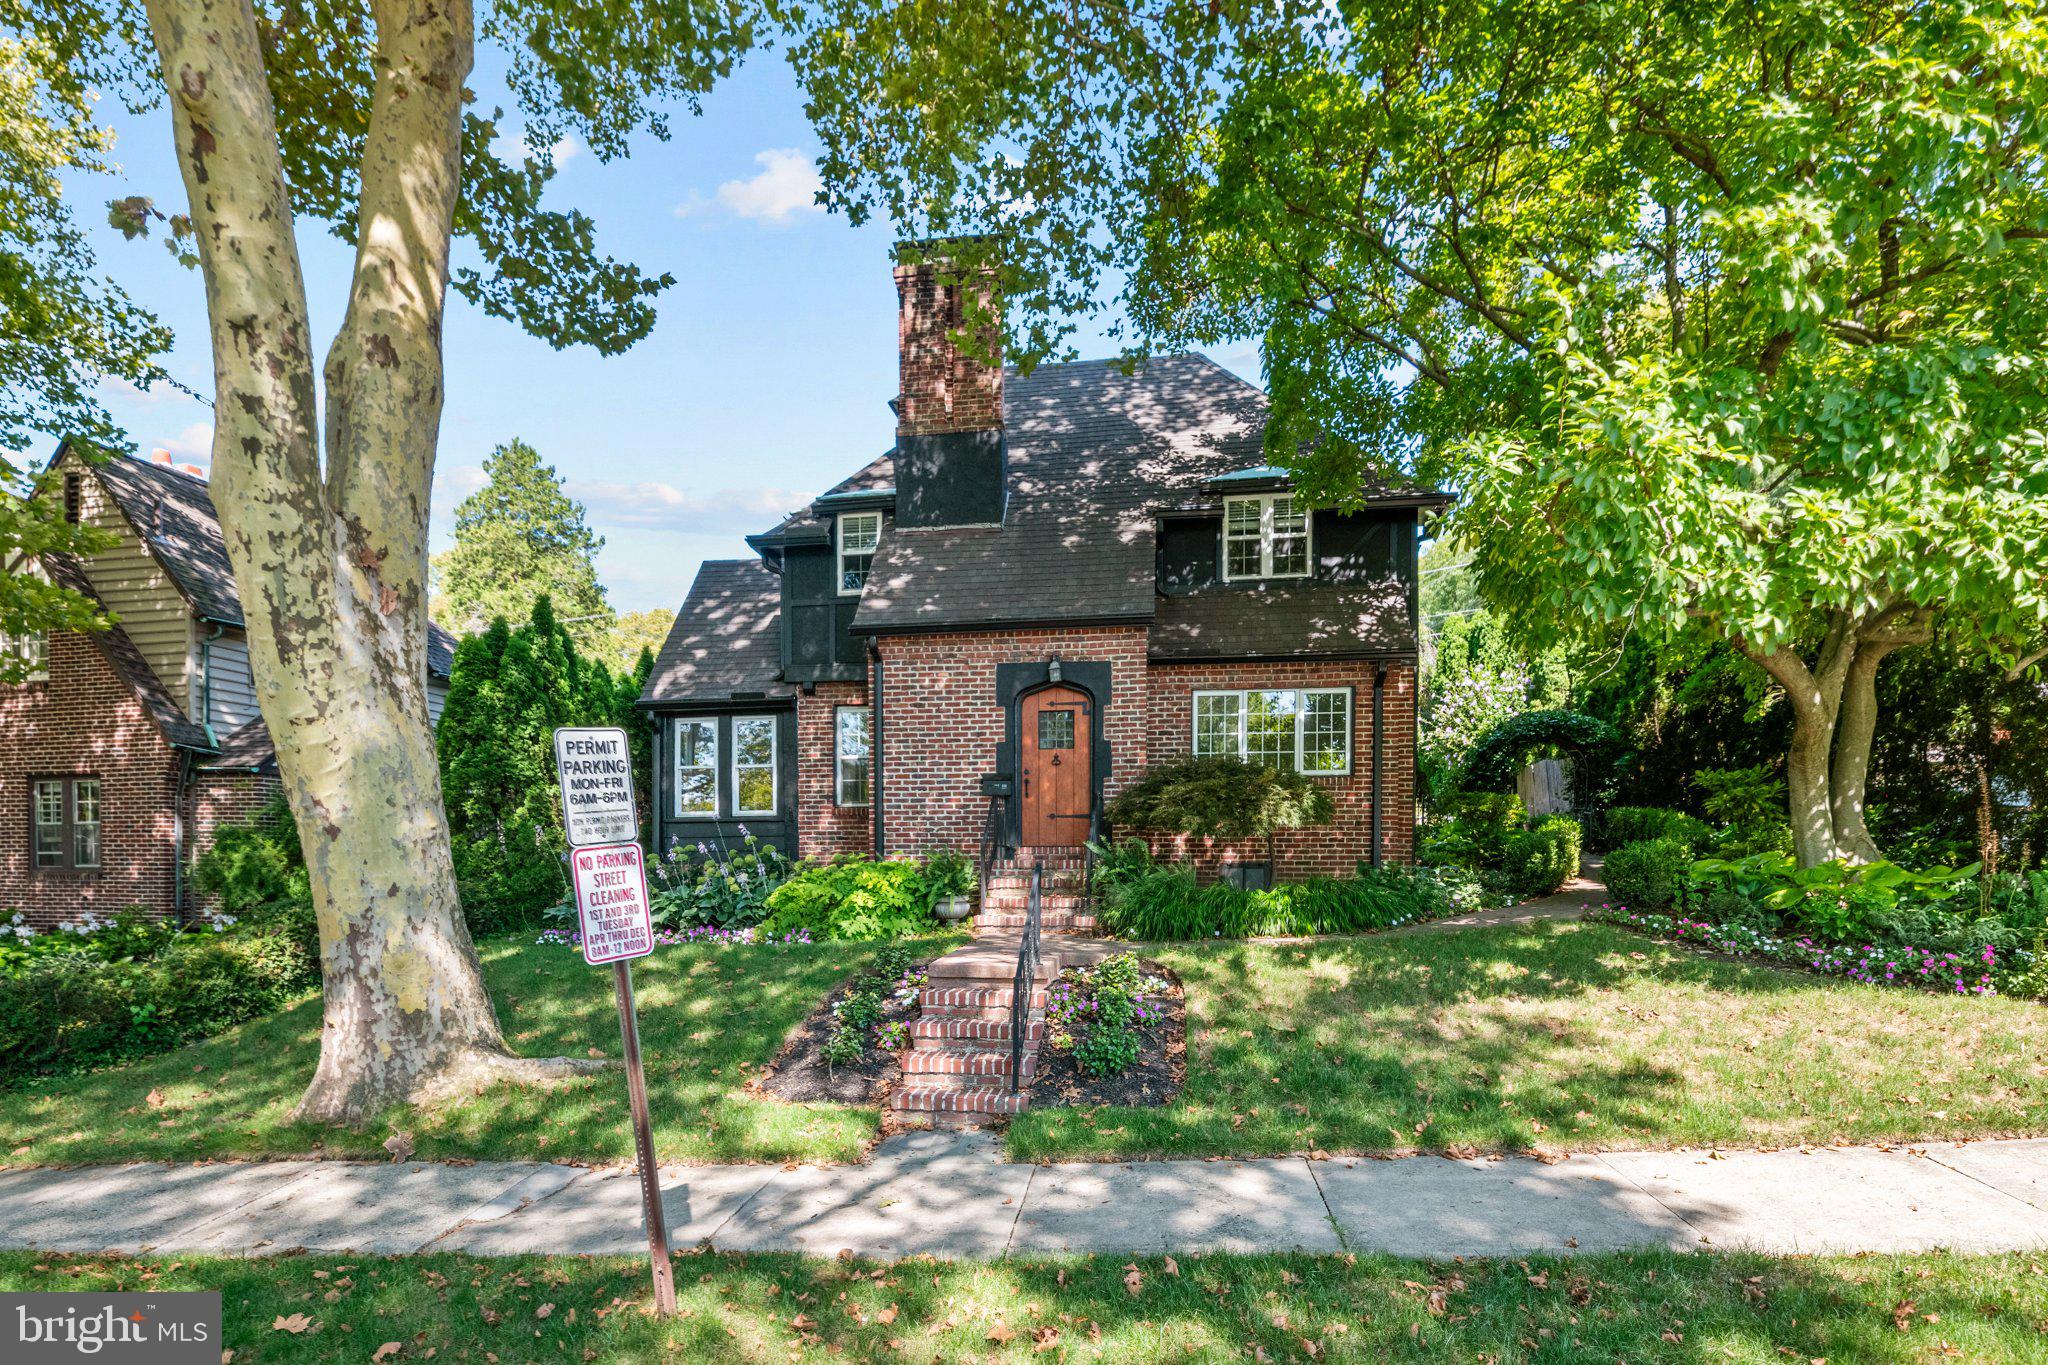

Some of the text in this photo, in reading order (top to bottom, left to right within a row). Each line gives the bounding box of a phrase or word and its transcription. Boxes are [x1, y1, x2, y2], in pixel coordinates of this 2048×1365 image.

[565, 740, 618, 755] PERMIT
[563, 759, 626, 776] PARKING
[570, 777, 624, 790] MON-FRI
[569, 791, 628, 805] 6AM-6PM
[578, 851, 637, 871] NO PARKING
[593, 870, 627, 888] STREET
[589, 887, 636, 907] CLEANING
[589, 903, 640, 921] 1ST AND 3RD
[597, 917, 634, 932] TUESDAY
[589, 926, 646, 945] APR THRU DEC
[623, 938, 647, 951] NOON
